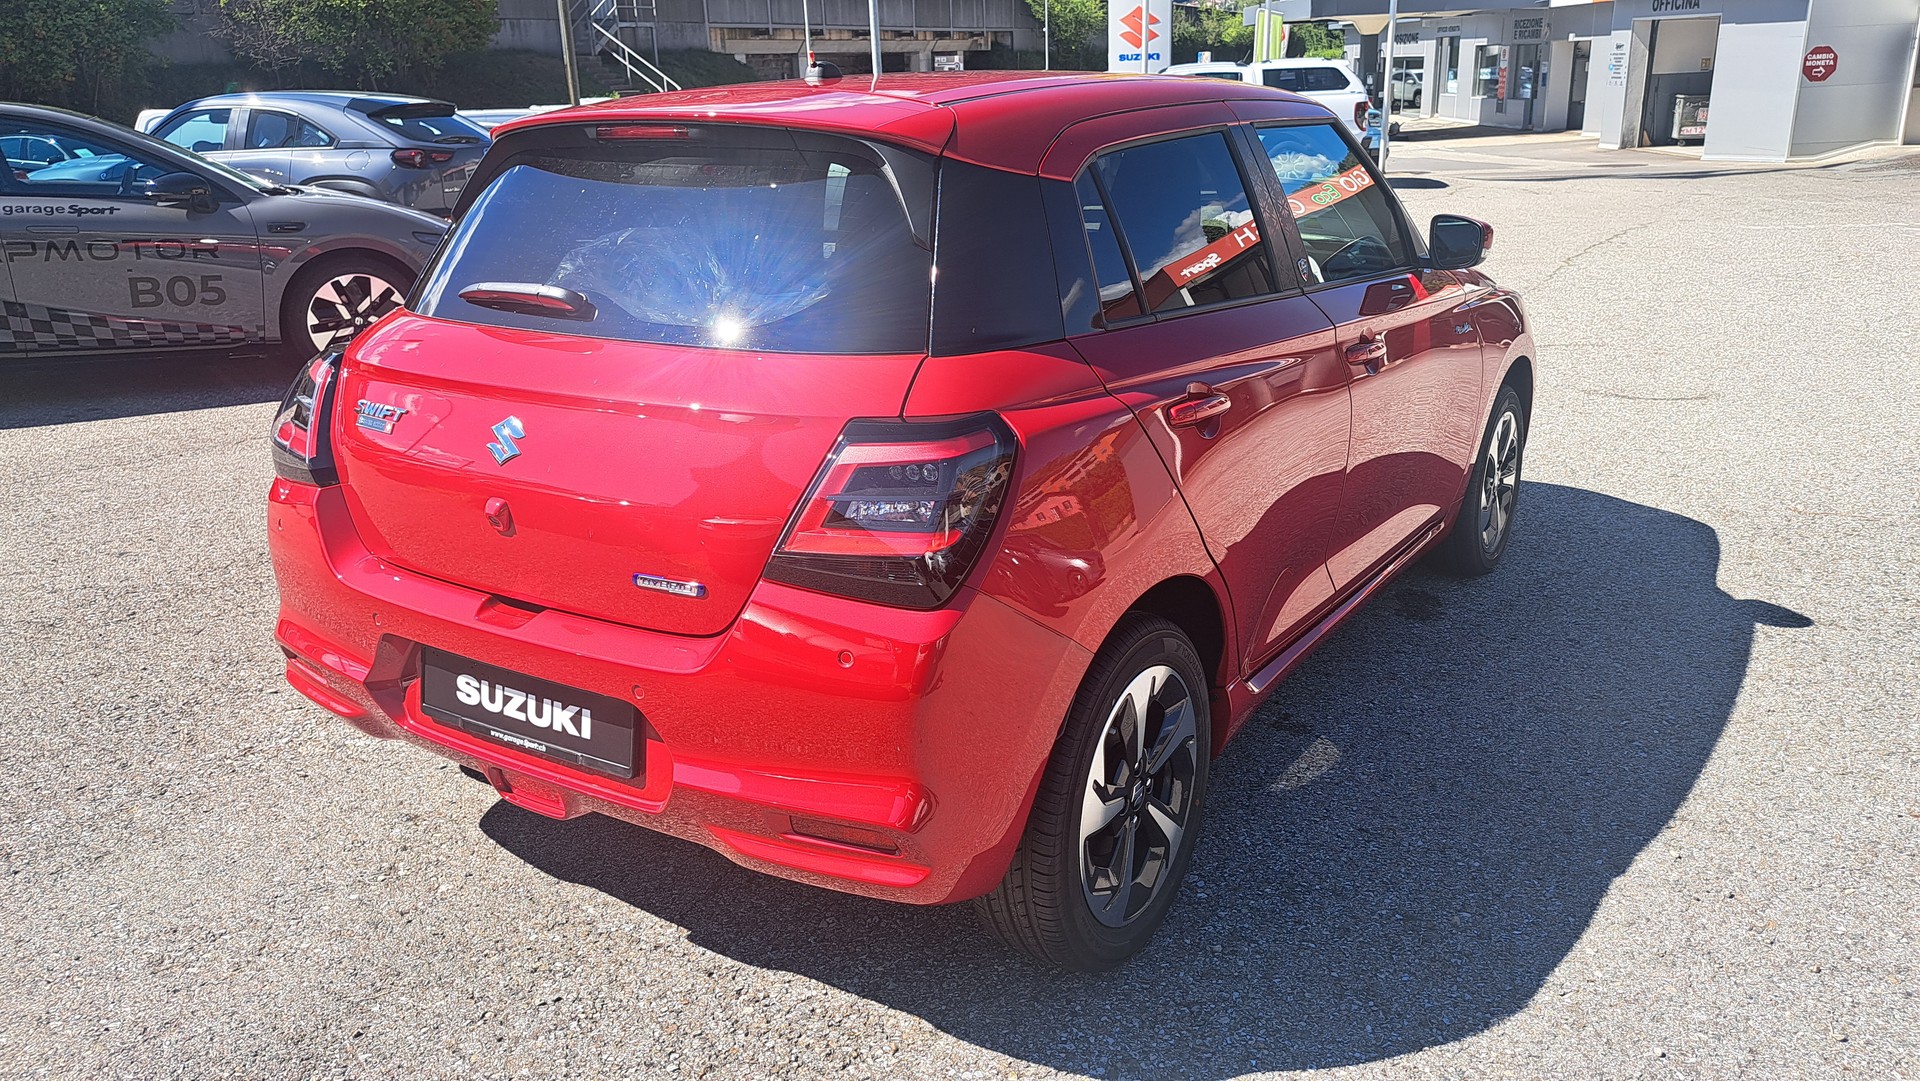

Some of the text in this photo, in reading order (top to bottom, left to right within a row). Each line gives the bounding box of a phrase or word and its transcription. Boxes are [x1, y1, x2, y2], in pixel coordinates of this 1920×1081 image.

[1652, 0, 1700, 12] OFFICINA
[1514, 17, 1544, 29] RICEZIONE
[1513, 29, 1542, 40] E RICAMBI
[1119, 53, 1160, 62] SUZKI
[2, 204, 120, 217] garage Sport
[0, 238, 220, 264] PMOTOR
[128, 274, 227, 309] B05
[354, 399, 409, 422] SWIFT
[456, 674, 592, 740] SUZUKI
